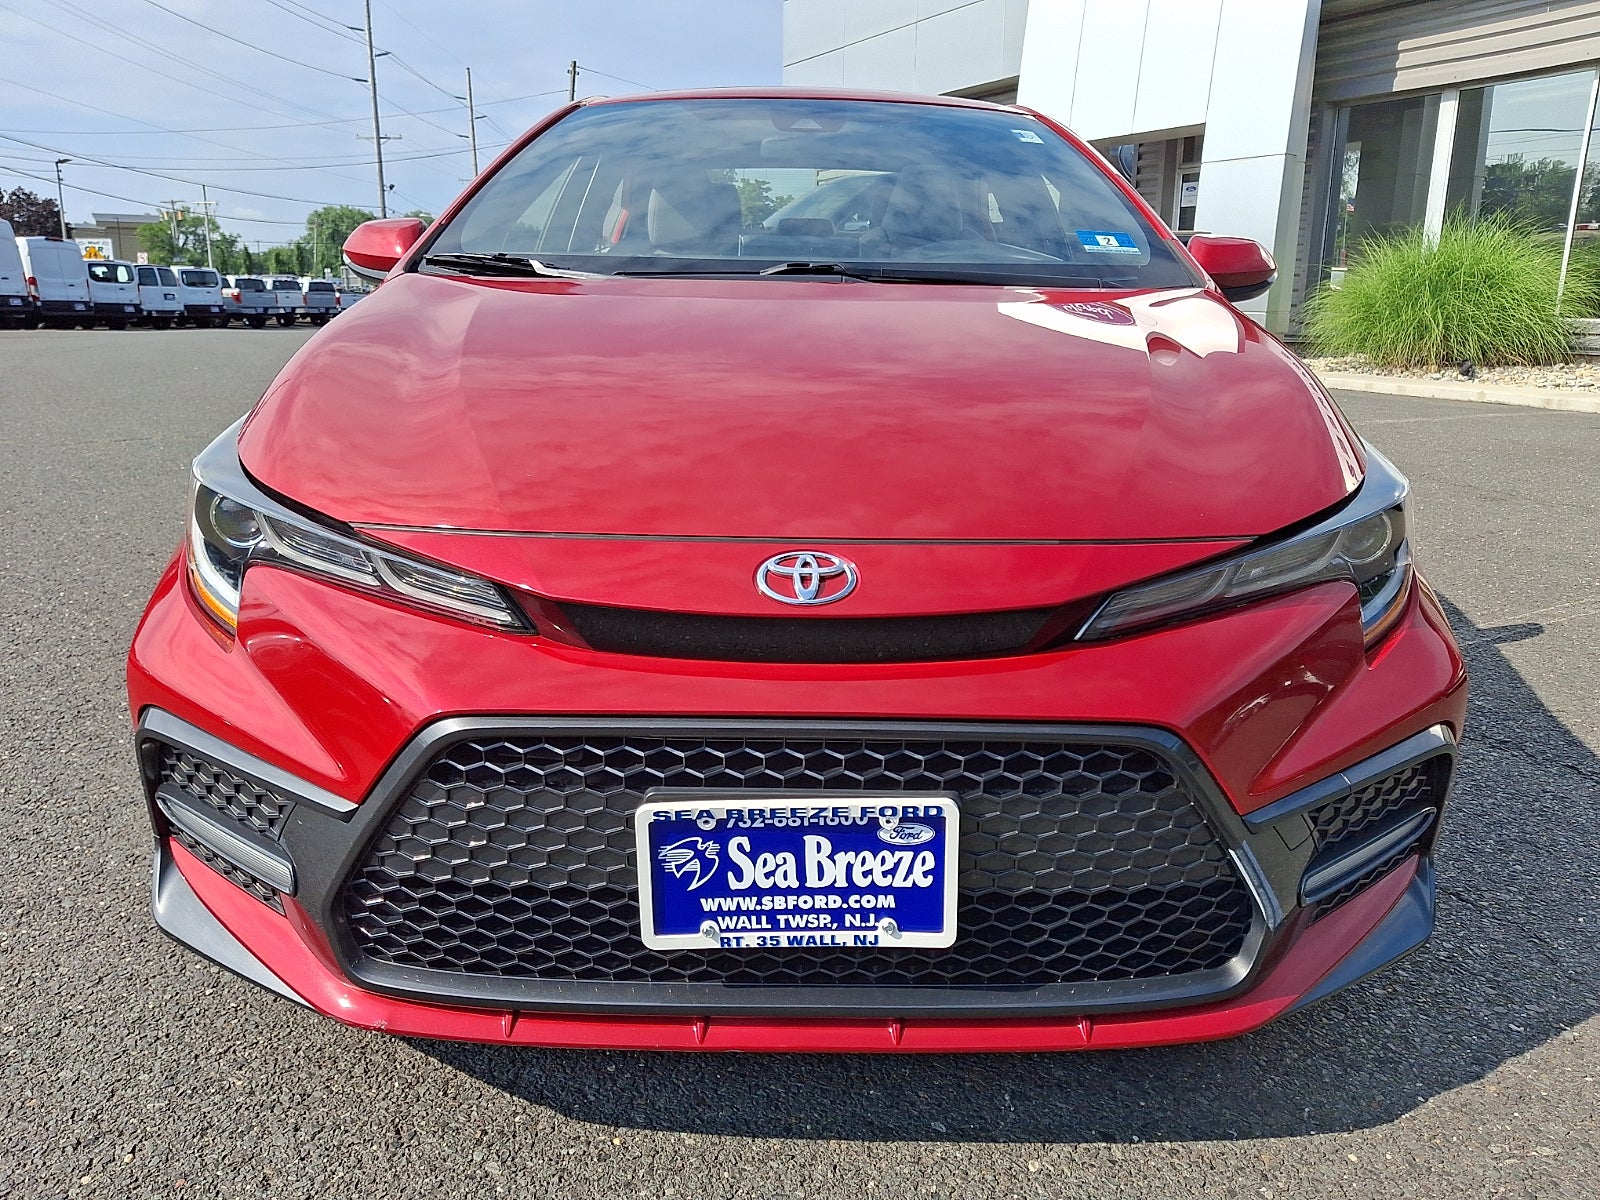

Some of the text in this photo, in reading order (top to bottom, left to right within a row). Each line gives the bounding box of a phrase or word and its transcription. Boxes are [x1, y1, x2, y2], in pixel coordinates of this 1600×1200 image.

[1103, 237, 1113, 246] 2
[653, 805, 943, 820] SEA BREEZE FORD
[889, 825, 923, 840] Ford
[727, 834, 936, 890] Sea Breeze
[700, 894, 896, 911] WWW.SBFORD.COM
[717, 915, 771, 930] WALL
[720, 934, 879, 948] RT. 35 WALL, NJ
